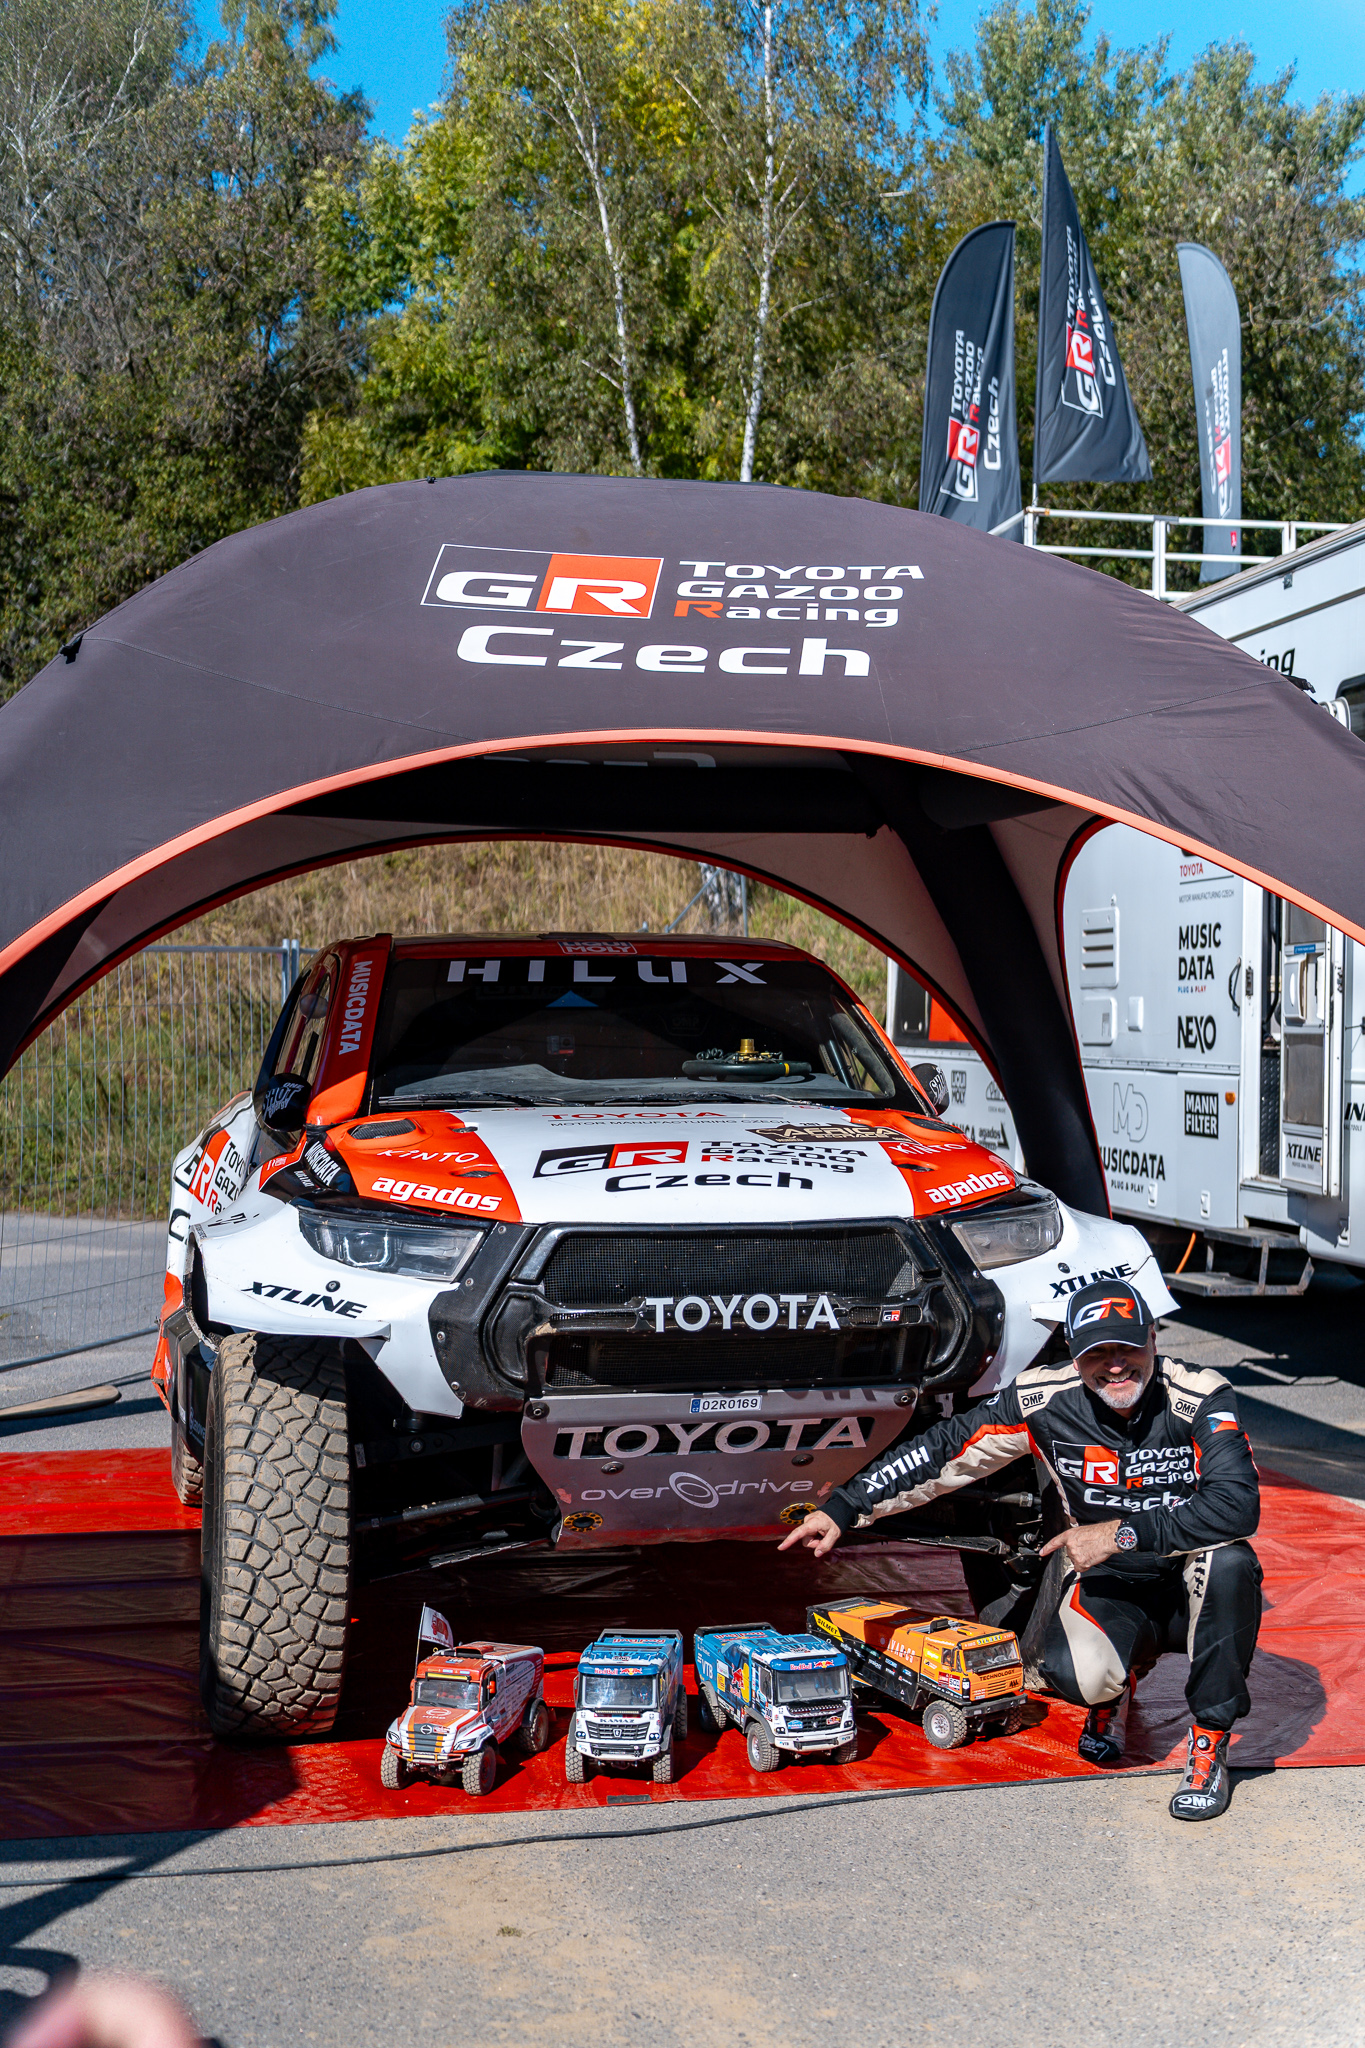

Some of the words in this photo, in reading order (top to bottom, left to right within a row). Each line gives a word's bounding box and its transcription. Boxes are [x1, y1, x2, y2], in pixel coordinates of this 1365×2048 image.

[951, 329, 965, 413] TOYOTA
[1072, 335, 1099, 411] GR
[984, 376, 1001, 471] Czech
[955, 427, 978, 498] GR
[678, 560, 925, 581] TOYOTA
[435, 570, 649, 614] GR
[676, 580, 905, 602] GAZOO
[673, 600, 900, 628] Racing
[455, 625, 872, 678] Czech
[1180, 862, 1204, 878] TOYOTA
[1178, 921, 1221, 950] MUSIC
[447, 960, 767, 984] HILUX
[1178, 955, 1215, 981] DATA
[1194, 985, 1206, 993] PLAY
[338, 960, 373, 1055] MUSICDATA
[1177, 1014, 1217, 1054] NEXO
[283, 1082, 304, 1090] ONE
[542, 1112, 727, 1120] TOYOTA
[1185, 1093, 1218, 1115] MANN
[1185, 1114, 1218, 1136] FILTER
[700, 1140, 868, 1157] TOYOTA
[700, 1147, 856, 1163] GAZOO
[1286, 1143, 1322, 1162] XTLINE
[304, 1141, 341, 1187] MUSICDATA
[539, 1149, 683, 1176] GR
[700, 1155, 855, 1174] Racing
[605, 1172, 813, 1192] Czech
[925, 1170, 1011, 1206] agados
[1110, 1180, 1124, 1190] PLUG
[1130, 1182, 1144, 1193] PLAY
[371, 1177, 502, 1212] agados
[241, 1281, 368, 1319] XTLINE
[645, 1294, 840, 1333] TOYOTA
[883, 1313, 900, 1322] GR
[1072, 1297, 1136, 1330] GR
[1022, 1393, 1044, 1407] OMP
[1174, 1400, 1197, 1416] OMP
[557, 1416, 867, 1460] TOYOTA
[1058, 1457, 1117, 1483] GR
[1126, 1470, 1195, 1489] Racing
[817, 1617, 839, 1635] SILMET
[979, 1669, 1015, 1682] TECHNOLOGY
